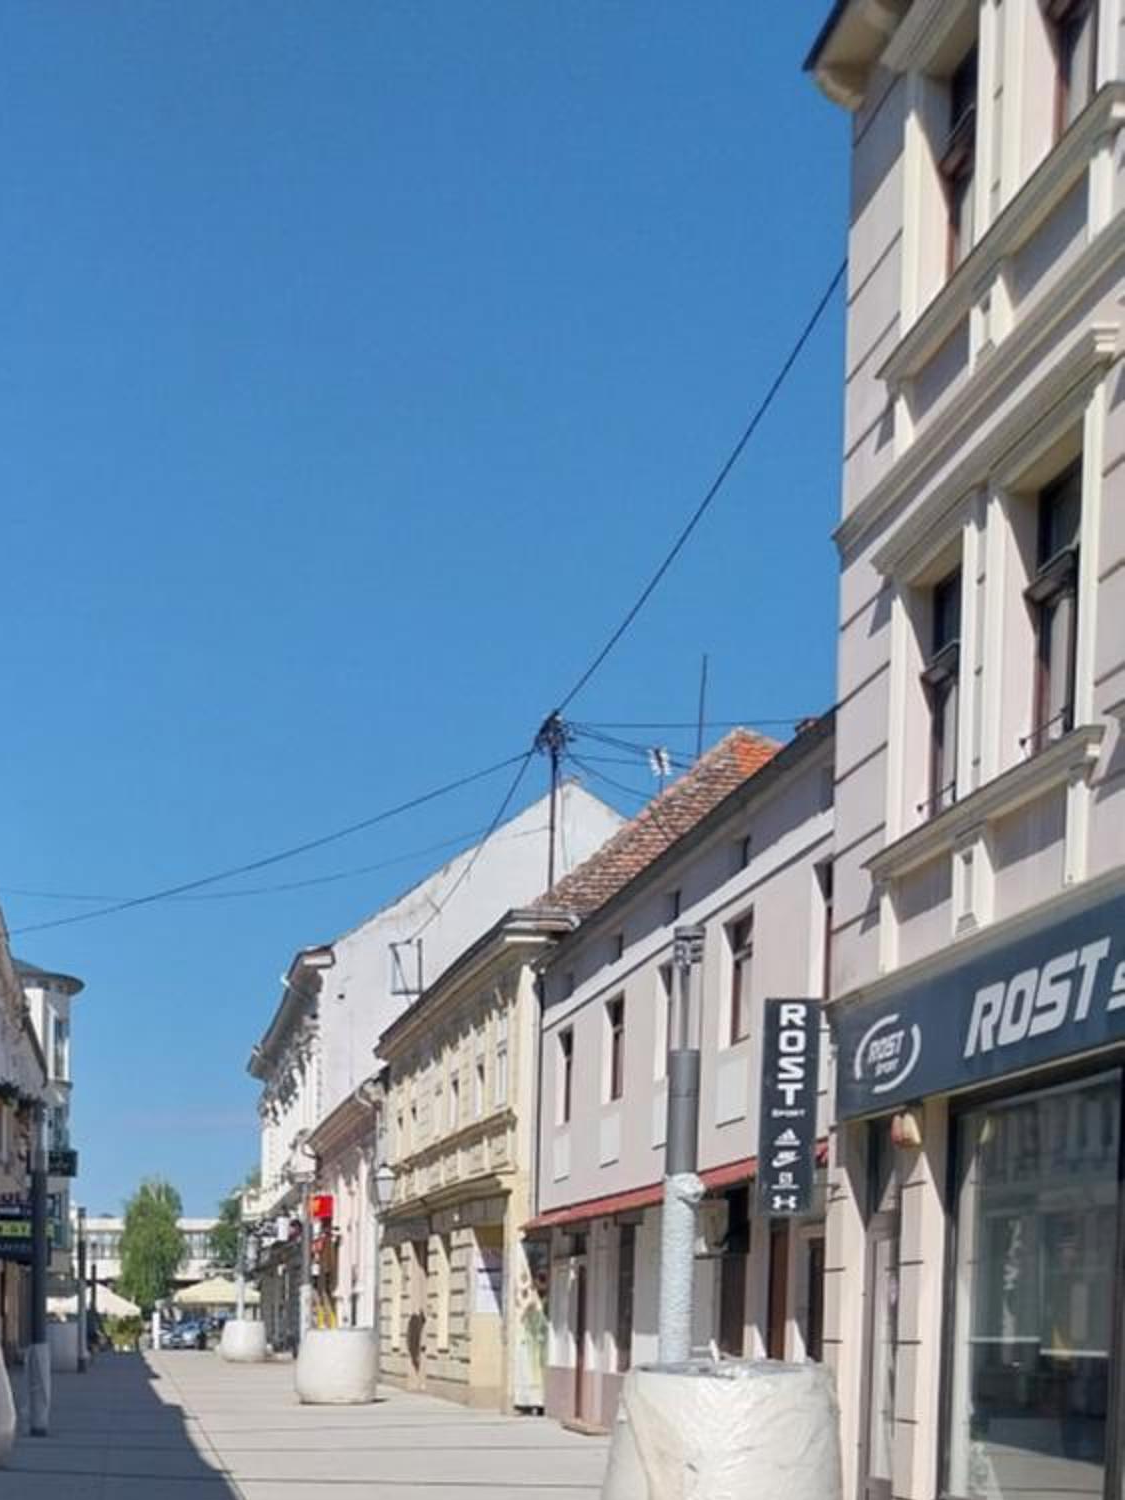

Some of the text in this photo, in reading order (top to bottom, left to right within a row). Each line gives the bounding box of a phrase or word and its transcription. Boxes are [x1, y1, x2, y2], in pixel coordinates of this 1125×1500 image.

[963, 935, 1111, 1060] ROST
[777, 1003, 807, 1106] ROST
[867, 1029, 904, 1064] ROST
[771, 1108, 806, 1118] SPORT
